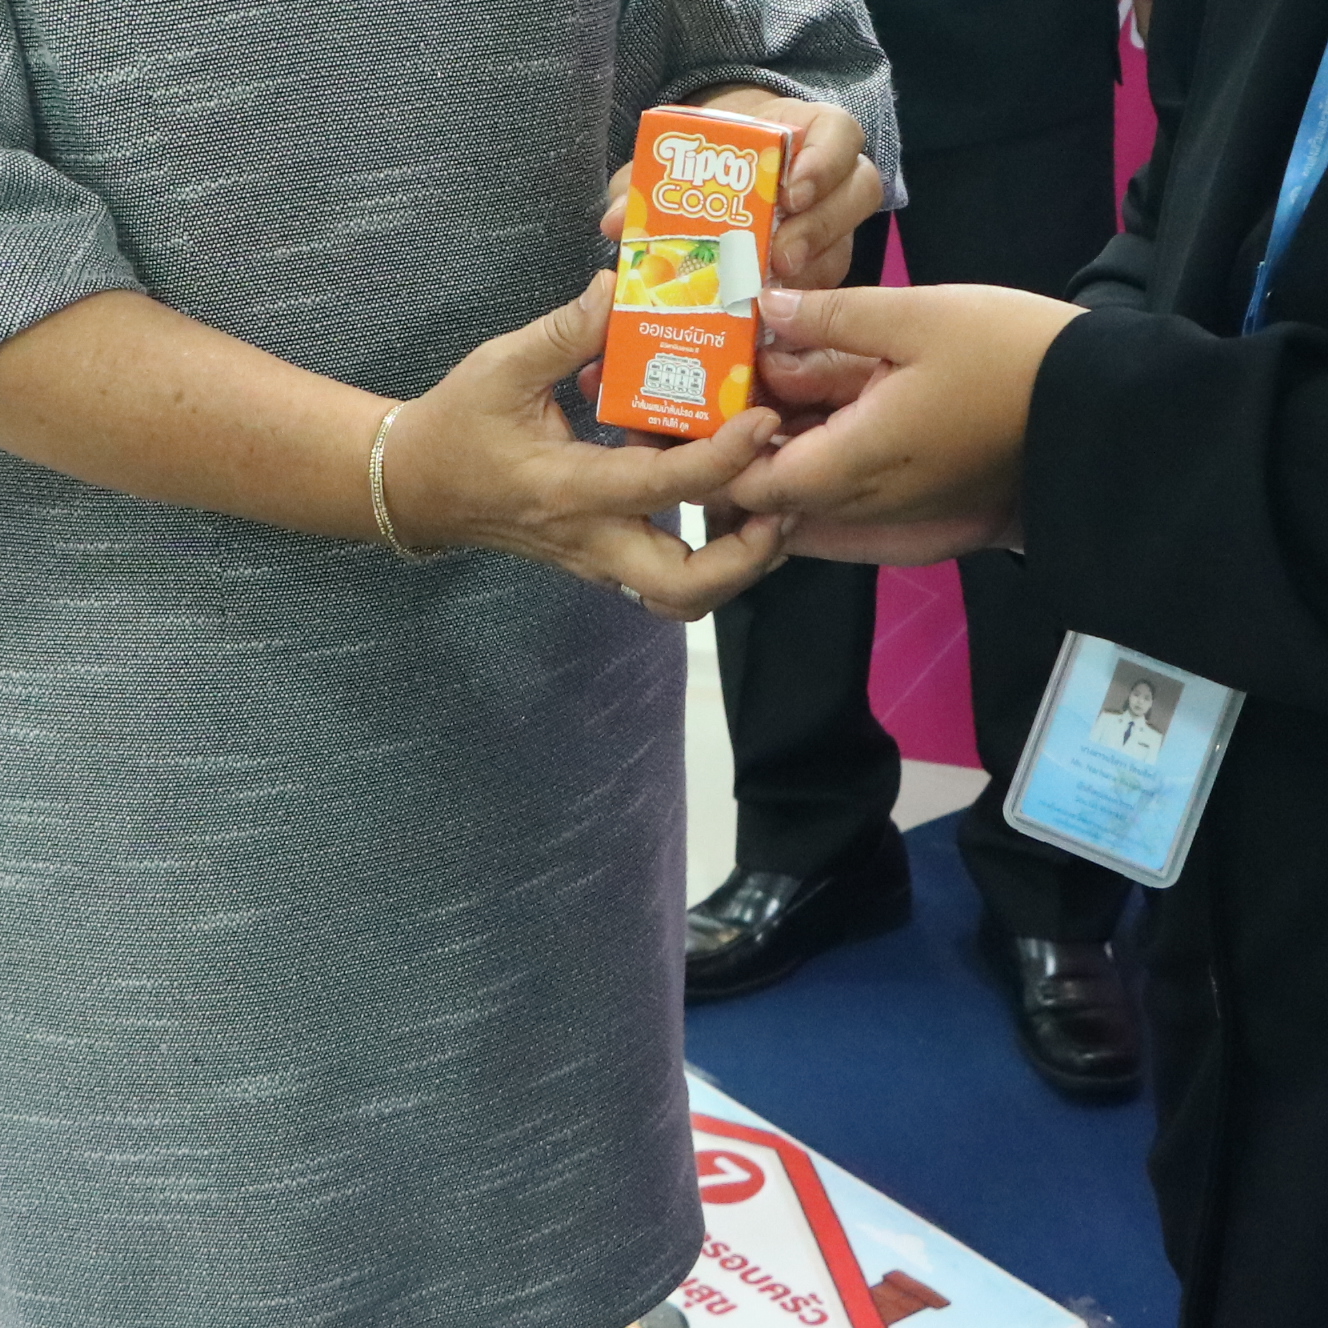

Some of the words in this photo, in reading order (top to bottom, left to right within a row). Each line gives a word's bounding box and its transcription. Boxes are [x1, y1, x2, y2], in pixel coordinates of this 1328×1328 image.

[660, 137, 750, 190] Tipco
[657, 183, 750, 222] COOL
[639, 322, 726, 348] ออเรนจ์มิกซ์
[702, 1232, 829, 1326] รอบครัว
